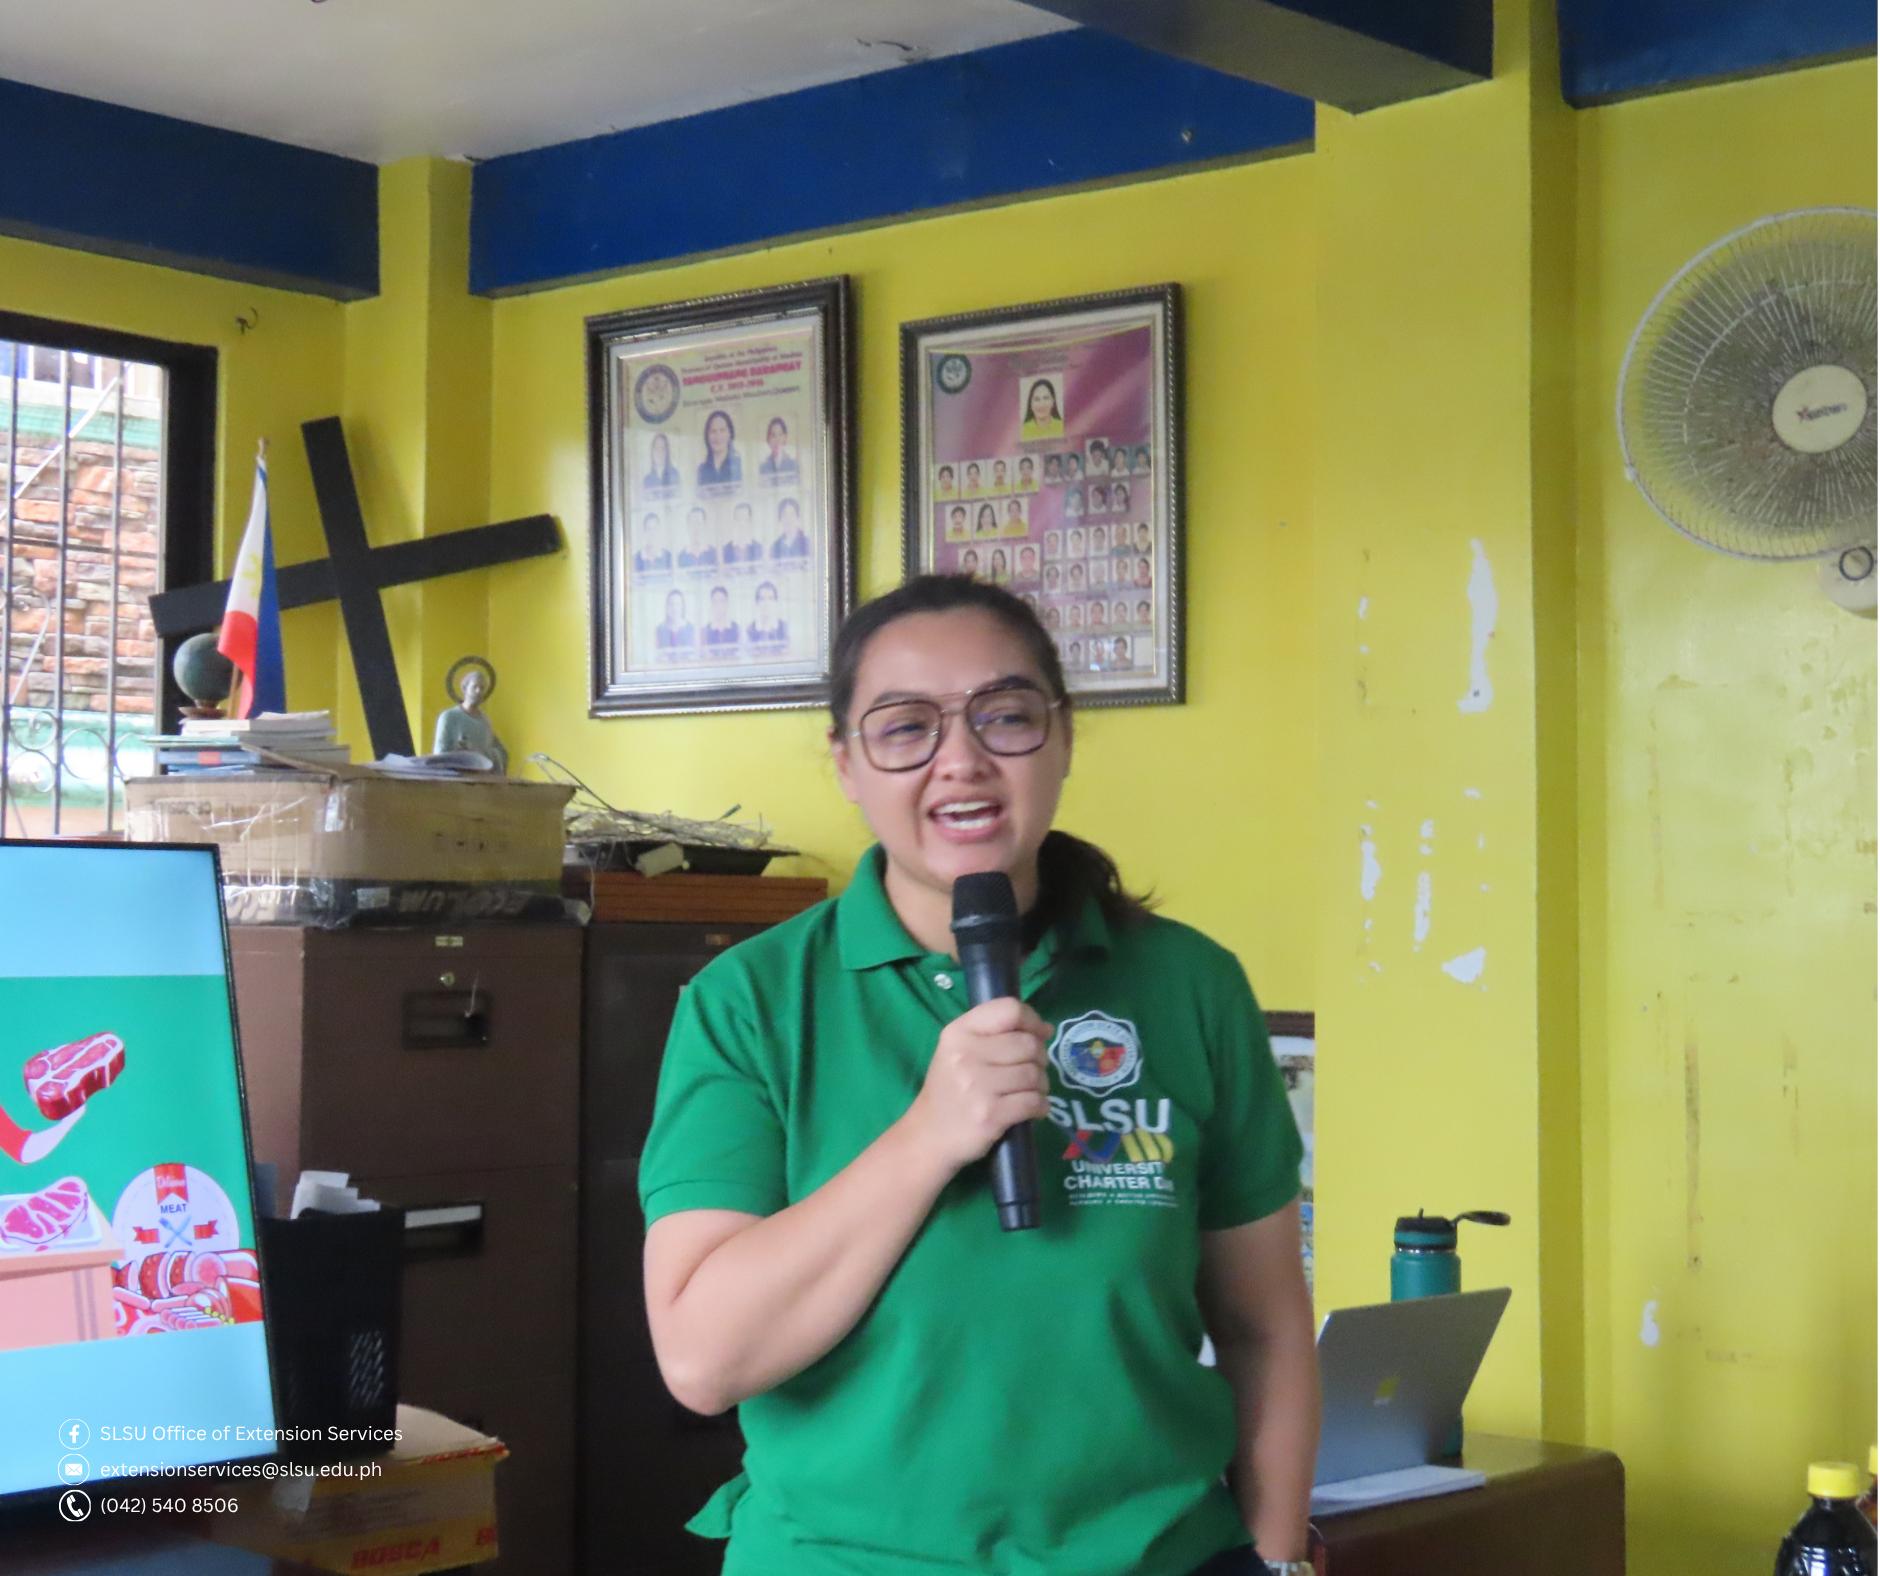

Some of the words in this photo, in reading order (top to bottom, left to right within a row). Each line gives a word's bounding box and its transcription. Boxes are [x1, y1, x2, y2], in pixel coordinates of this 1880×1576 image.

[1046, 1096, 1170, 1134] SLSU
[1063, 1174, 1151, 1190] CHARTER
[160, 1203, 187, 1214] MEAT
